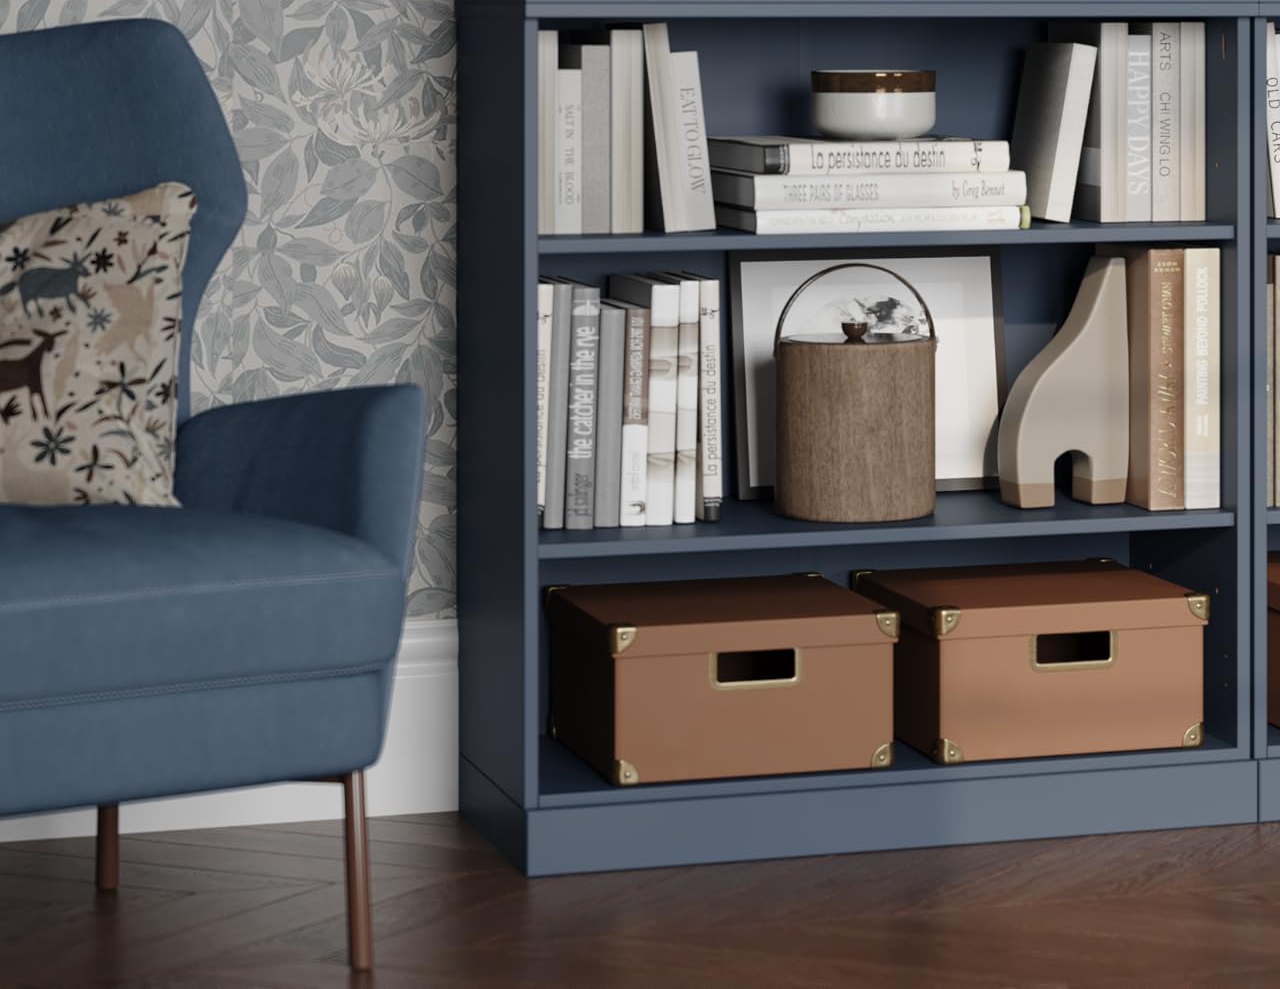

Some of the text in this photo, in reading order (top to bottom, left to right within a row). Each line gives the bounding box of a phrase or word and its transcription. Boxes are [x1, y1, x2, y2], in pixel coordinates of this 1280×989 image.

[1265, 77, 1280, 110] OLD
[680, 88, 706, 195] EAT TO GLOW
[1127, 50, 1151, 195] HAPPY DAYS
[784, 182, 879, 202] THREE PAIRS OF GLASSES
[1195, 266, 1209, 313] POLLOCK
[1195, 315, 1209, 356] BEYOND
[567, 326, 600, 459] the catcher in the rye
[1195, 359, 1209, 405] PAINTING
[701, 344, 723, 476] La persistance du destin
